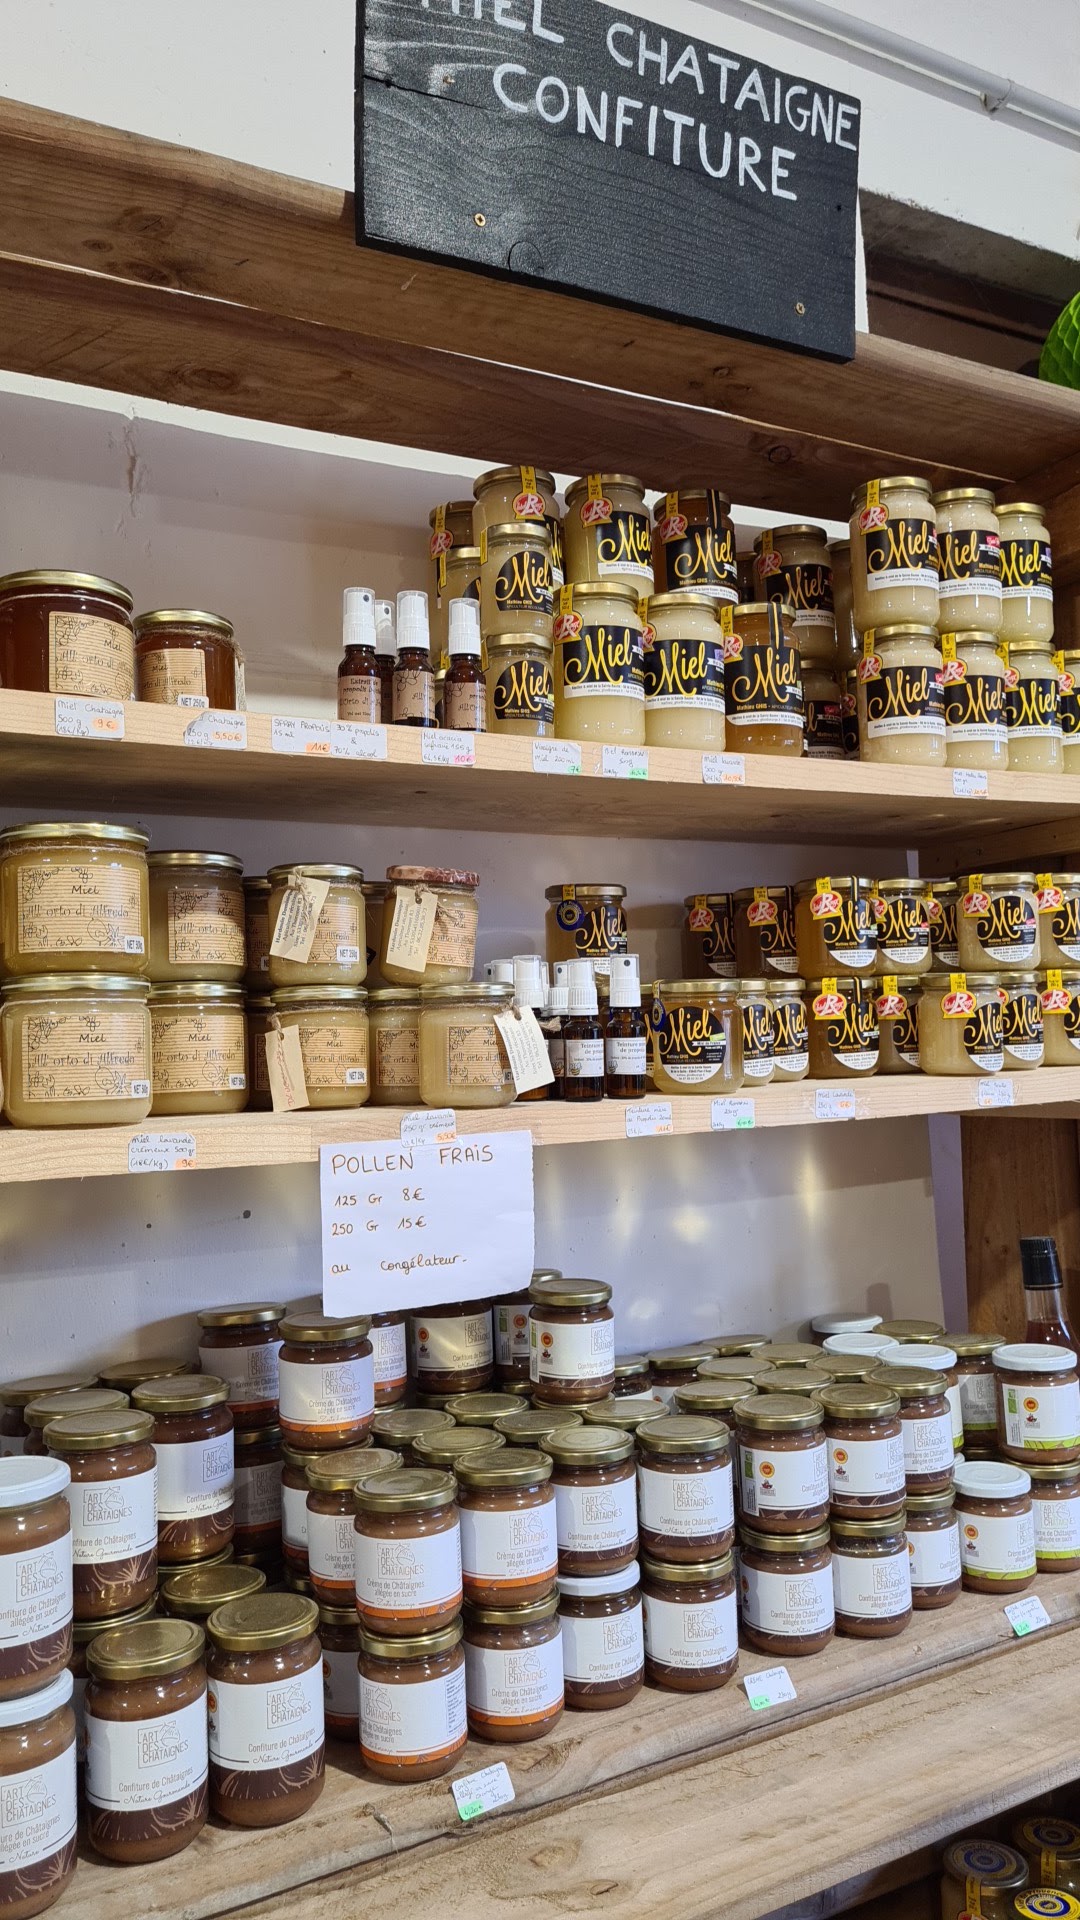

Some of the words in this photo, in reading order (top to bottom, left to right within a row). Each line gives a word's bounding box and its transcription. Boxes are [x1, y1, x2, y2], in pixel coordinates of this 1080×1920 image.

[421, 0, 564, 44] EL
[606, 23, 859, 151] CHATAIGNE
[493, 63, 798, 200] CONFITURE
[598, 514, 652, 567] Miel
[674, 527, 734, 579] Miel
[868, 521, 931, 573] Miel
[937, 531, 980, 580] Miel
[494, 551, 550, 603] Miel
[1000, 542, 1042, 588] Miel
[770, 566, 825, 611] Miel
[565, 627, 634, 685] Miel
[644, 641, 708, 697] Miel
[732, 647, 797, 703] Miel
[494, 660, 550, 712] Miel
[868, 668, 931, 722] Miel
[945, 677, 1004, 727] Miel
[1005, 681, 1058, 728] Miel
[71, 884, 100, 896] Miel
[576, 906, 624, 950] Miel
[823, 900, 871, 943] Miel
[877, 899, 923, 942] Miel
[977, 896, 1028, 940] Miel
[78, 1033, 107, 1043] Miel
[188, 1033, 211, 1042] Miel
[659, 1007, 712, 1057] Miel
[773, 1003, 806, 1047] Miel
[1002, 994, 1042, 1037] Miel
[331, 1149, 414, 1175] POLLEN
[334, 1194, 357, 1207] 125
[367, 1193, 383, 1205] Gr
[402, 1187, 426, 1202] 8€
[331, 1223, 354, 1237] 250
[366, 1220, 380, 1232] Gr
[397, 1215, 428, 1230] 15€
[331, 1264, 352, 1274] au
[279, 1739, 288, 1749] de
[118, 1782, 150, 1793] Confiture
[151, 1780, 160, 1789] de
